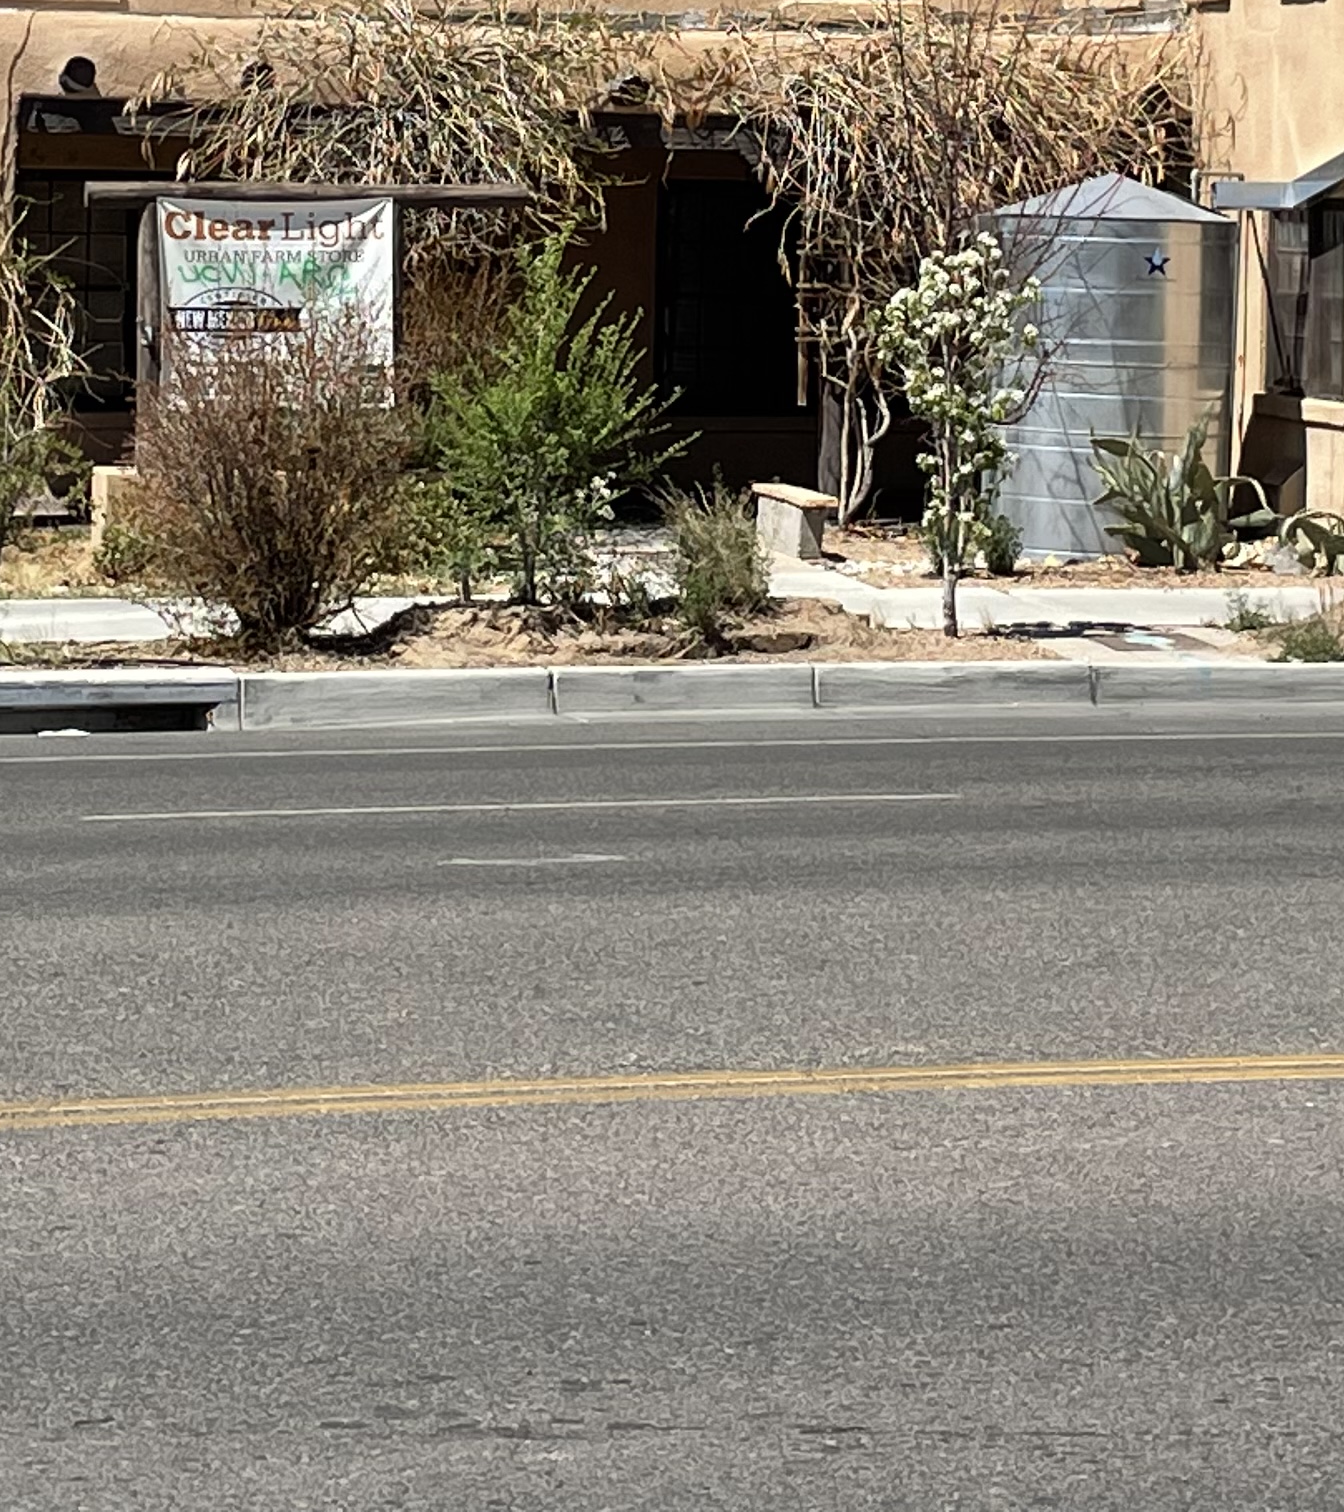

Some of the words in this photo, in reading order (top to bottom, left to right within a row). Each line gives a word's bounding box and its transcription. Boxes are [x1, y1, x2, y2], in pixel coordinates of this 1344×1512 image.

[163, 210, 276, 242] Clear
[280, 211, 384, 248] Light
[184, 250, 248, 264] URBAN
[251, 249, 302, 264] FARM
[307, 249, 365, 264] STORE
